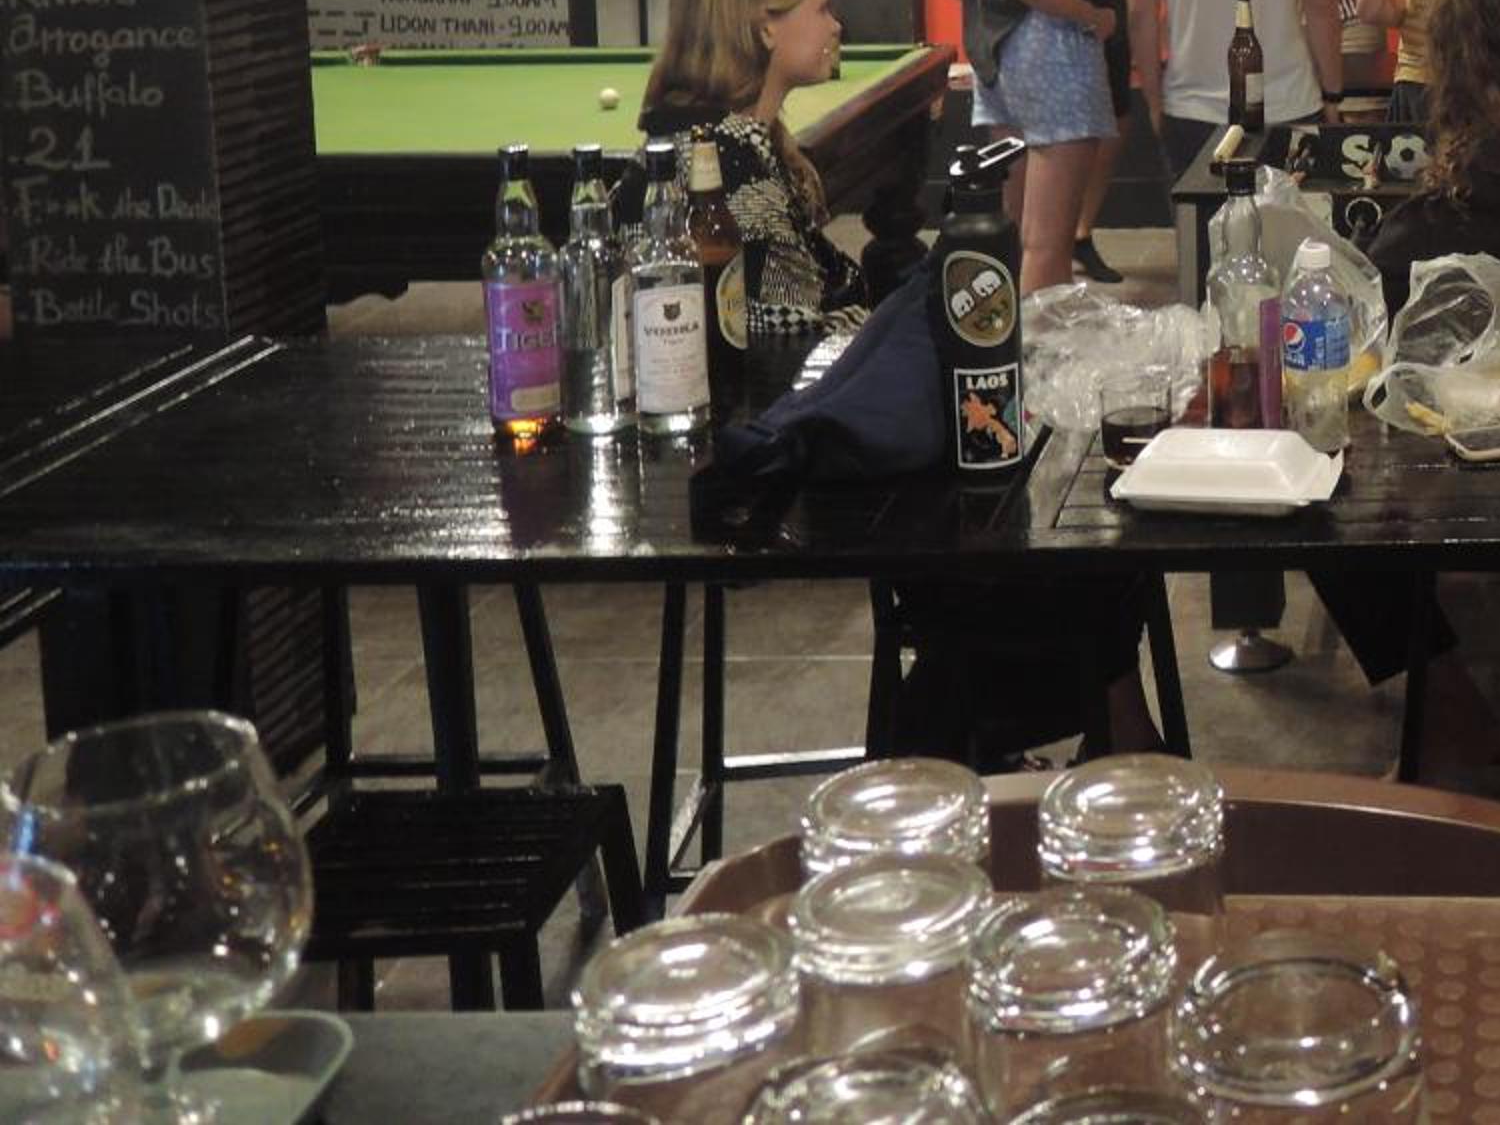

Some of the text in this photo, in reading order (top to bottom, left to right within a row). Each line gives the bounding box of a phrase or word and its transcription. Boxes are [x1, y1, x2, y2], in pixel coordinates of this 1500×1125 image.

[15, 68, 164, 119] Buffalo
[24, 125, 112, 171] 21
[147, 235, 216, 278] Bus
[966, 374, 1009, 390] LAOS
